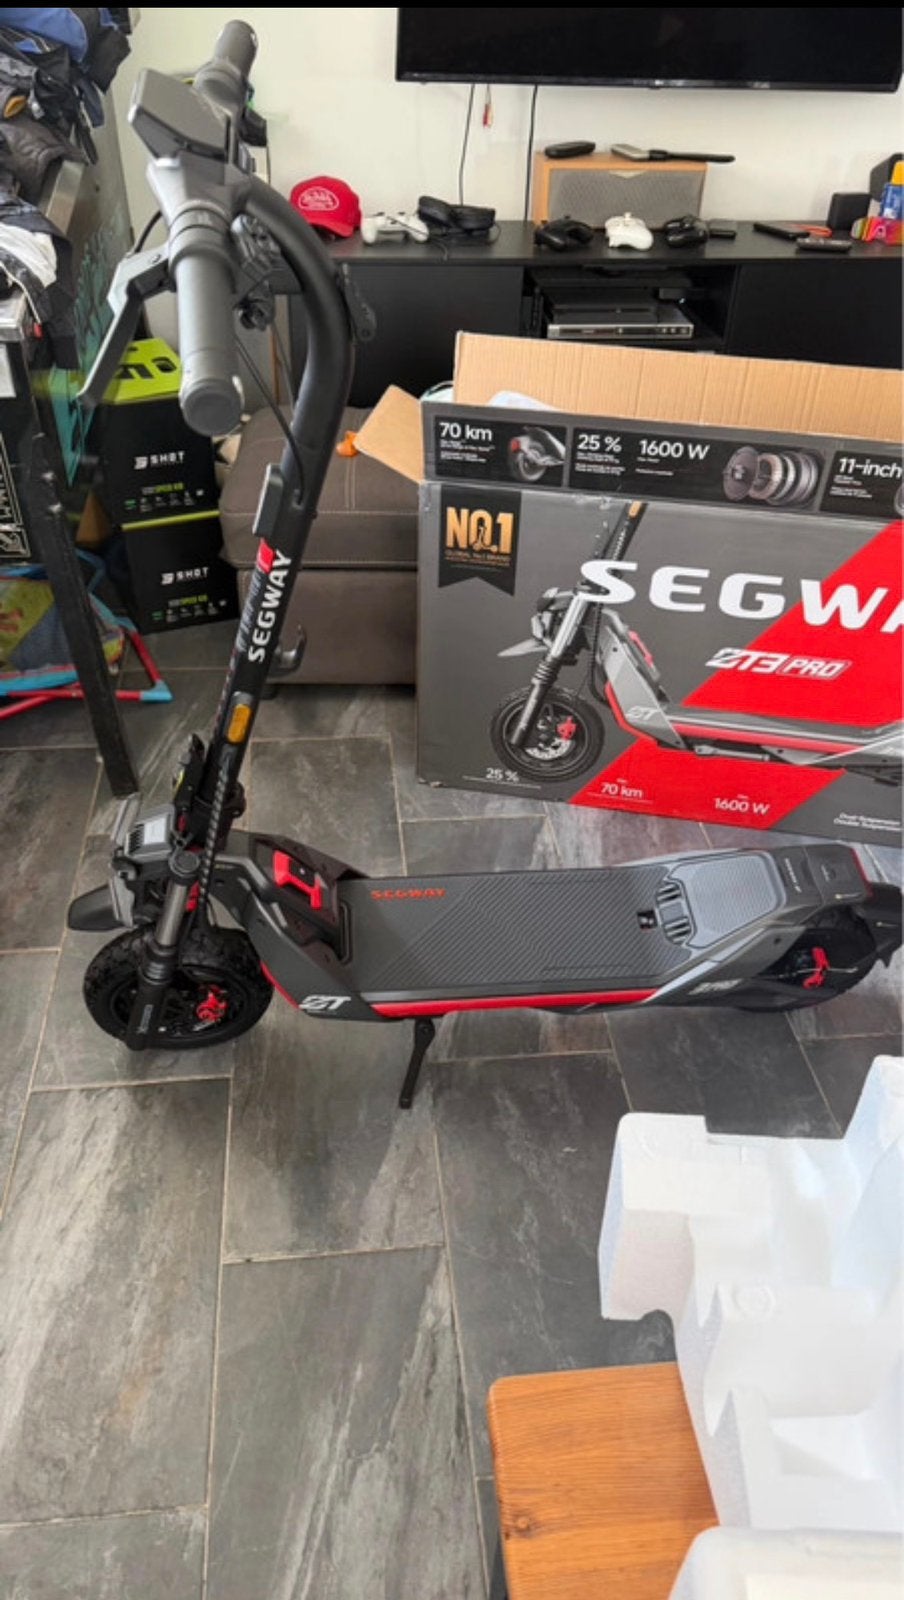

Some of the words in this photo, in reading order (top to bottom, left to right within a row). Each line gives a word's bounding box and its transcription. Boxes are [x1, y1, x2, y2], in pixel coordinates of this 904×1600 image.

[439, 422, 461, 438] 70
[465, 424, 493, 441] km
[577, 434, 600, 451] 25
[604, 436, 622, 453] %
[639, 439, 684, 458] 1600
[688, 443, 710, 460] W
[839, 456, 902, 478] 11-inch
[248, 549, 292, 662] SEGWAY
[781, 659, 846, 678] PRO
[486, 766, 503, 780] 25
[504, 770, 520, 783] %
[601, 782, 618, 796] 70
[620, 785, 643, 799] km
[714, 797, 749, 812] 1600
[752, 803, 770, 815] W
[370, 887, 447, 902] SEGWAY
